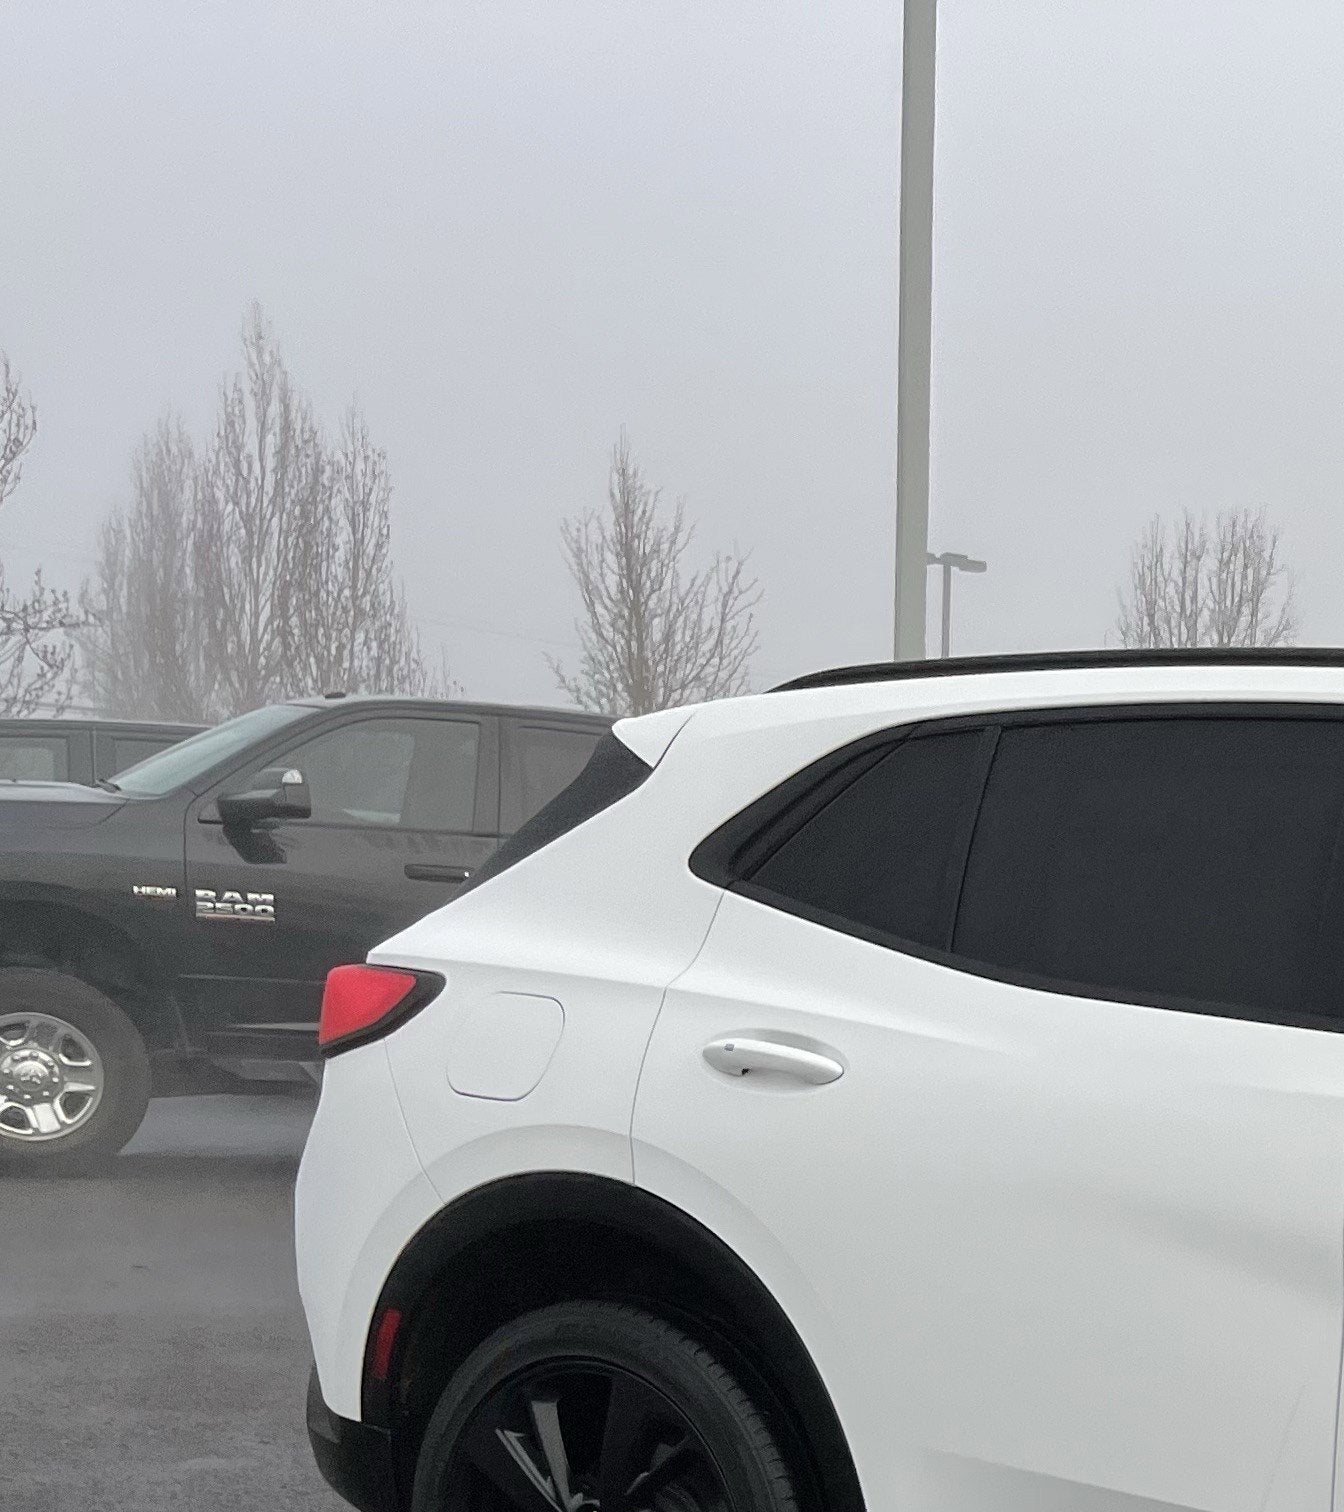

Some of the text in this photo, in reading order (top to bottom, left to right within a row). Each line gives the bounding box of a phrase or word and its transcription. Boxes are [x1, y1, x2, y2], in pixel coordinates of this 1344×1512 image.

[132, 885, 178, 898] HEMI
[195, 888, 275, 905] RAM
[195, 901, 276, 917] 2500
